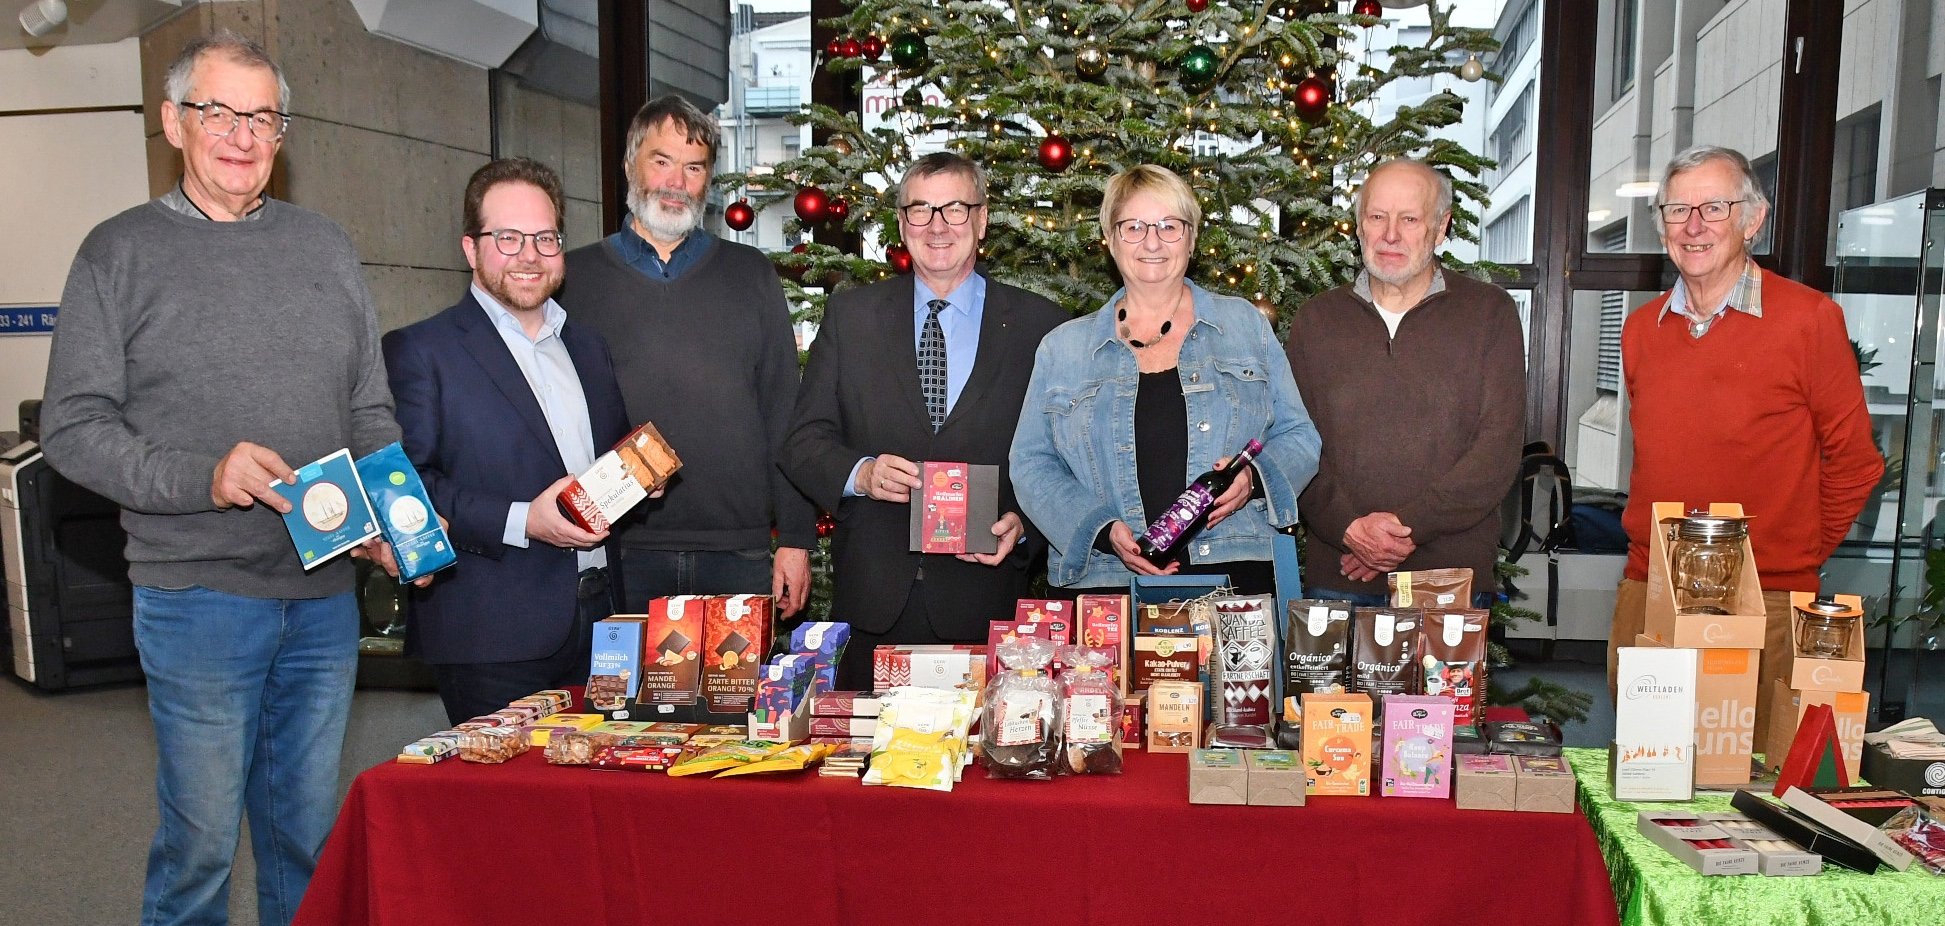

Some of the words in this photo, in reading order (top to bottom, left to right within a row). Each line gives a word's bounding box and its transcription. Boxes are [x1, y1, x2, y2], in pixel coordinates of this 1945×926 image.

[17, 314, 34, 327] 241
[599, 479, 635, 511] Spekulatius
[1221, 625, 1267, 640] KAFFEE
[594, 653, 628, 661] Vollmilch
[1289, 651, 1332, 664] Orgánico
[593, 660, 608, 668] Pur
[1144, 659, 1187, 668] Kakao-Pulver
[1357, 661, 1401, 674] Orgánico
[647, 675, 678, 683] MANDEL
[730, 678, 755, 686] BITTER
[1637, 685, 1684, 693] WELTLADEN
[1159, 703, 1190, 711] MANDELN
[1312, 719, 1335, 730] FAIR
[1392, 719, 1415, 730] FAIR
[1324, 745, 1352, 753] Curcuma
